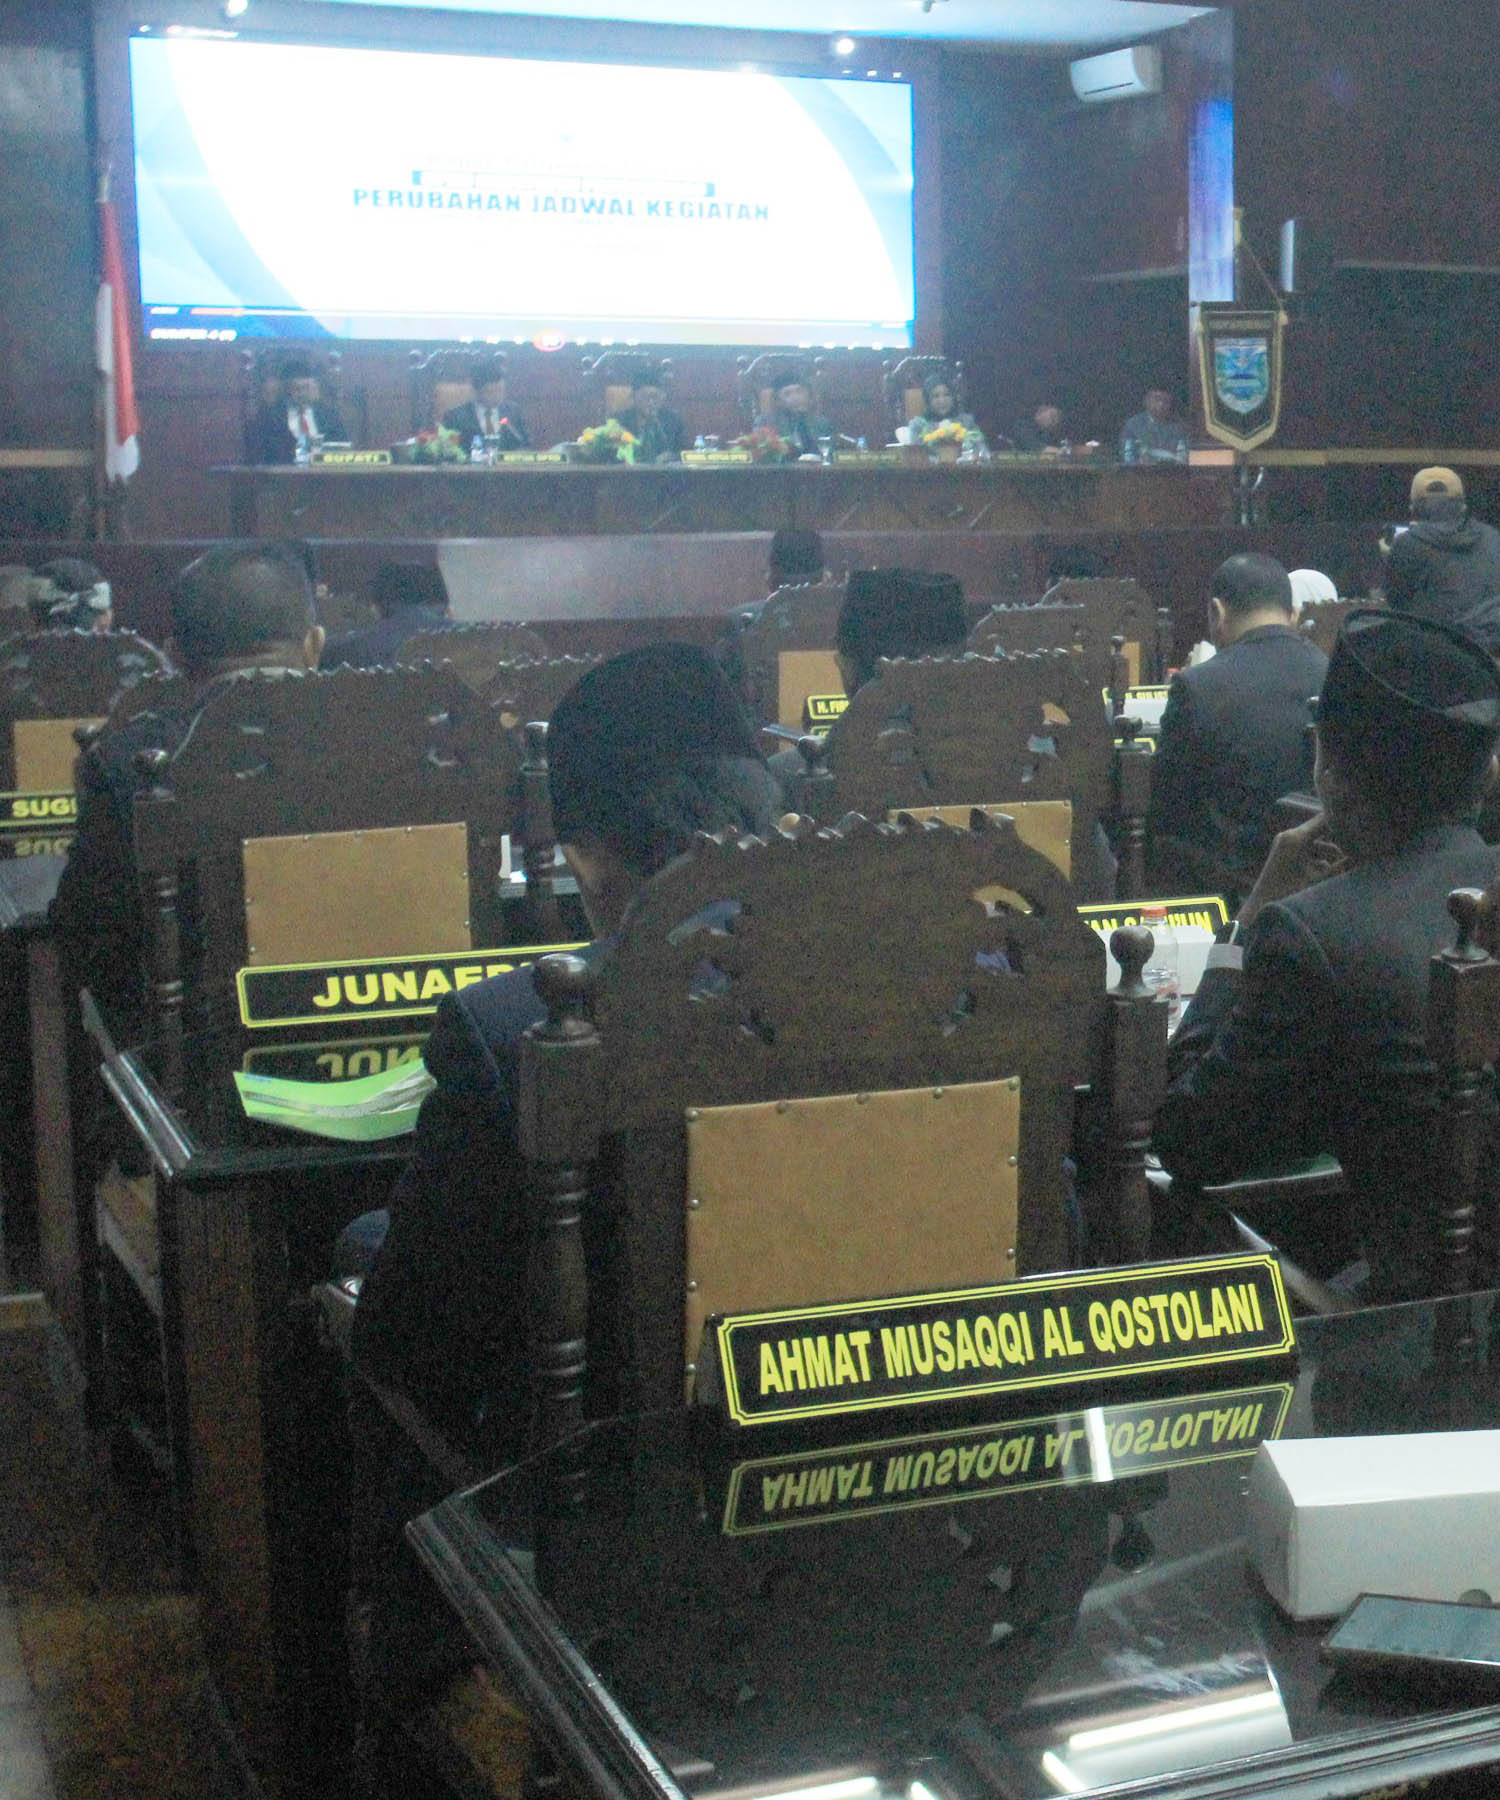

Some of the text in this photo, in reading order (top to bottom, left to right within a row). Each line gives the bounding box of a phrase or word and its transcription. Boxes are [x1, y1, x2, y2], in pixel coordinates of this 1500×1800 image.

[353, 188, 769, 221] PERUBAHAN JADWAL KEGIATAN
[760, 1284, 1264, 1395] AHMAT MUSAQQI AL QOSTOLANI
